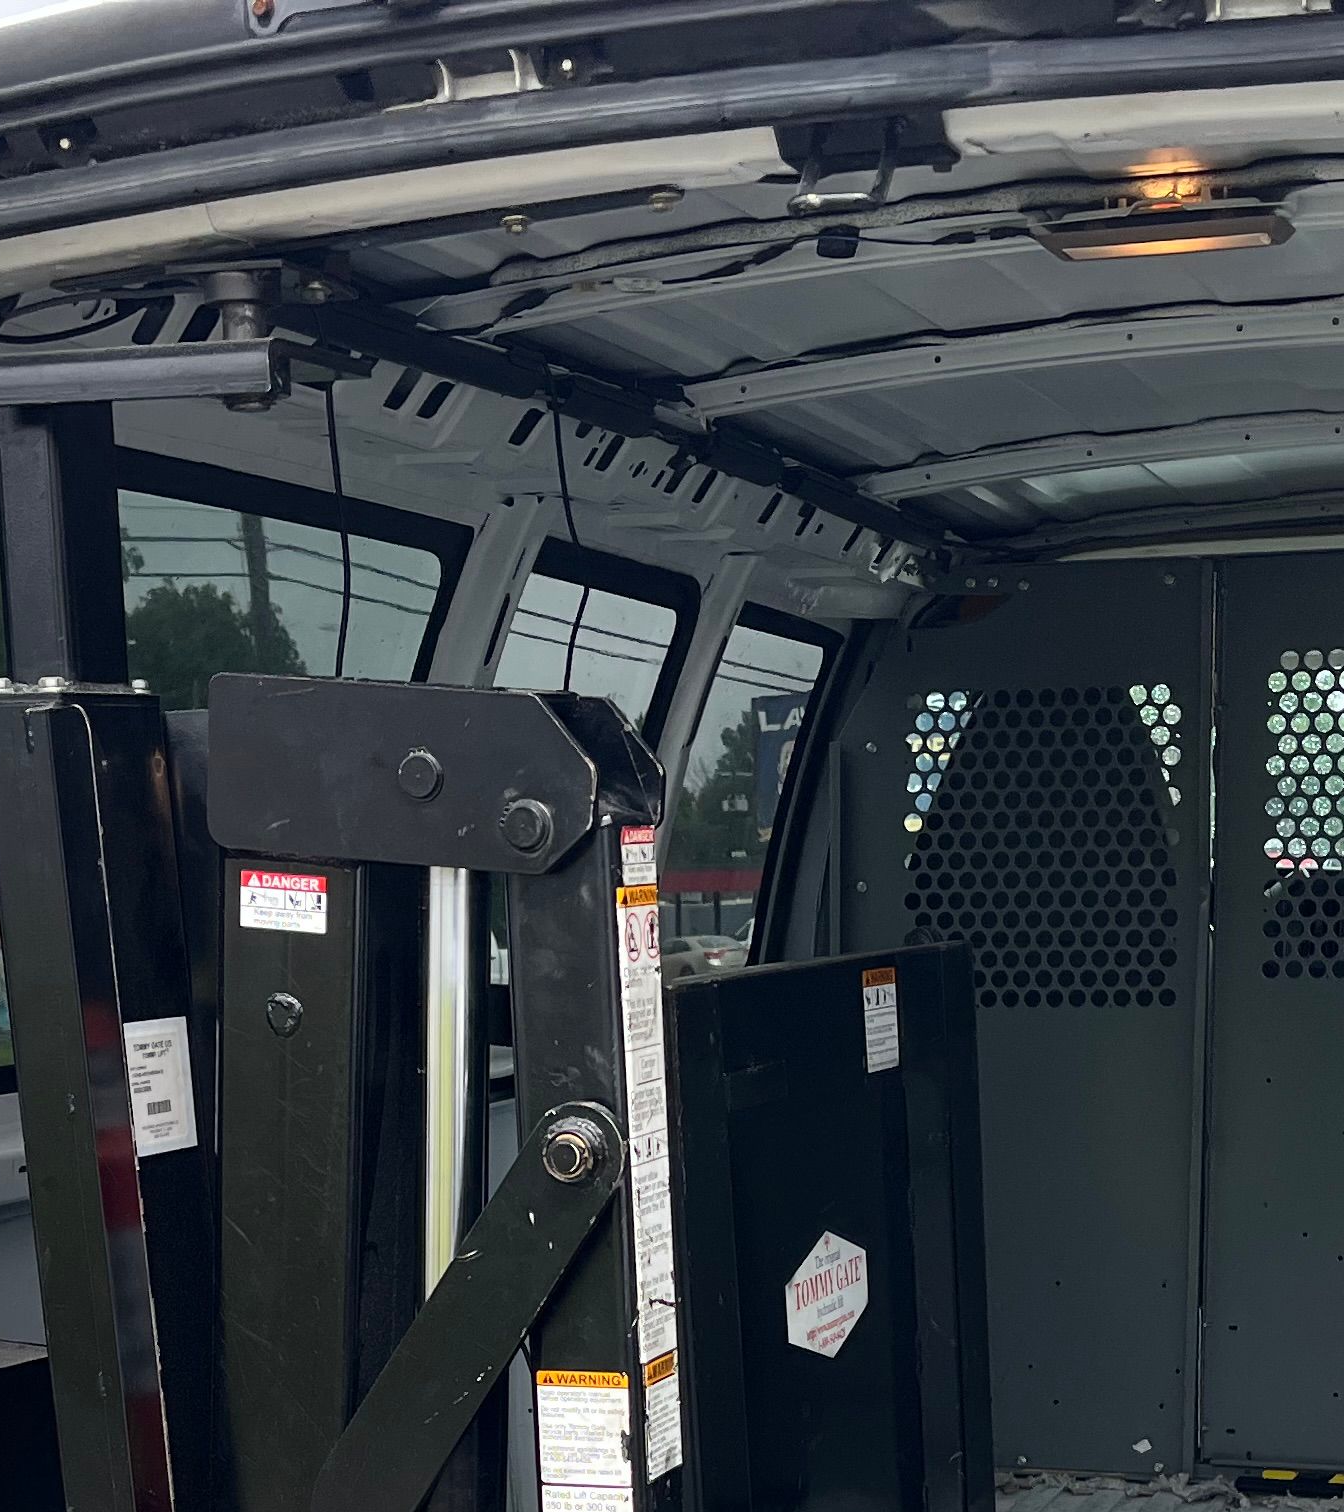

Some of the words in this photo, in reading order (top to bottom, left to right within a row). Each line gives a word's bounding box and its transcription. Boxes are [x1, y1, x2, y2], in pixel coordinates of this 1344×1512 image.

[261, 874, 320, 891] DANGER
[793, 1268, 834, 1311] TOMMY
[836, 1255, 862, 1291] GATE
[556, 1373, 622, 1387] WARNING
[545, 1489, 571, 1499] Rated
[574, 1491, 587, 1500] Lift
[589, 1491, 627, 1502] Capacity
[564, 1501, 573, 1511] lb
[586, 1502, 603, 1512] 300
[605, 1503, 617, 1512] kg
